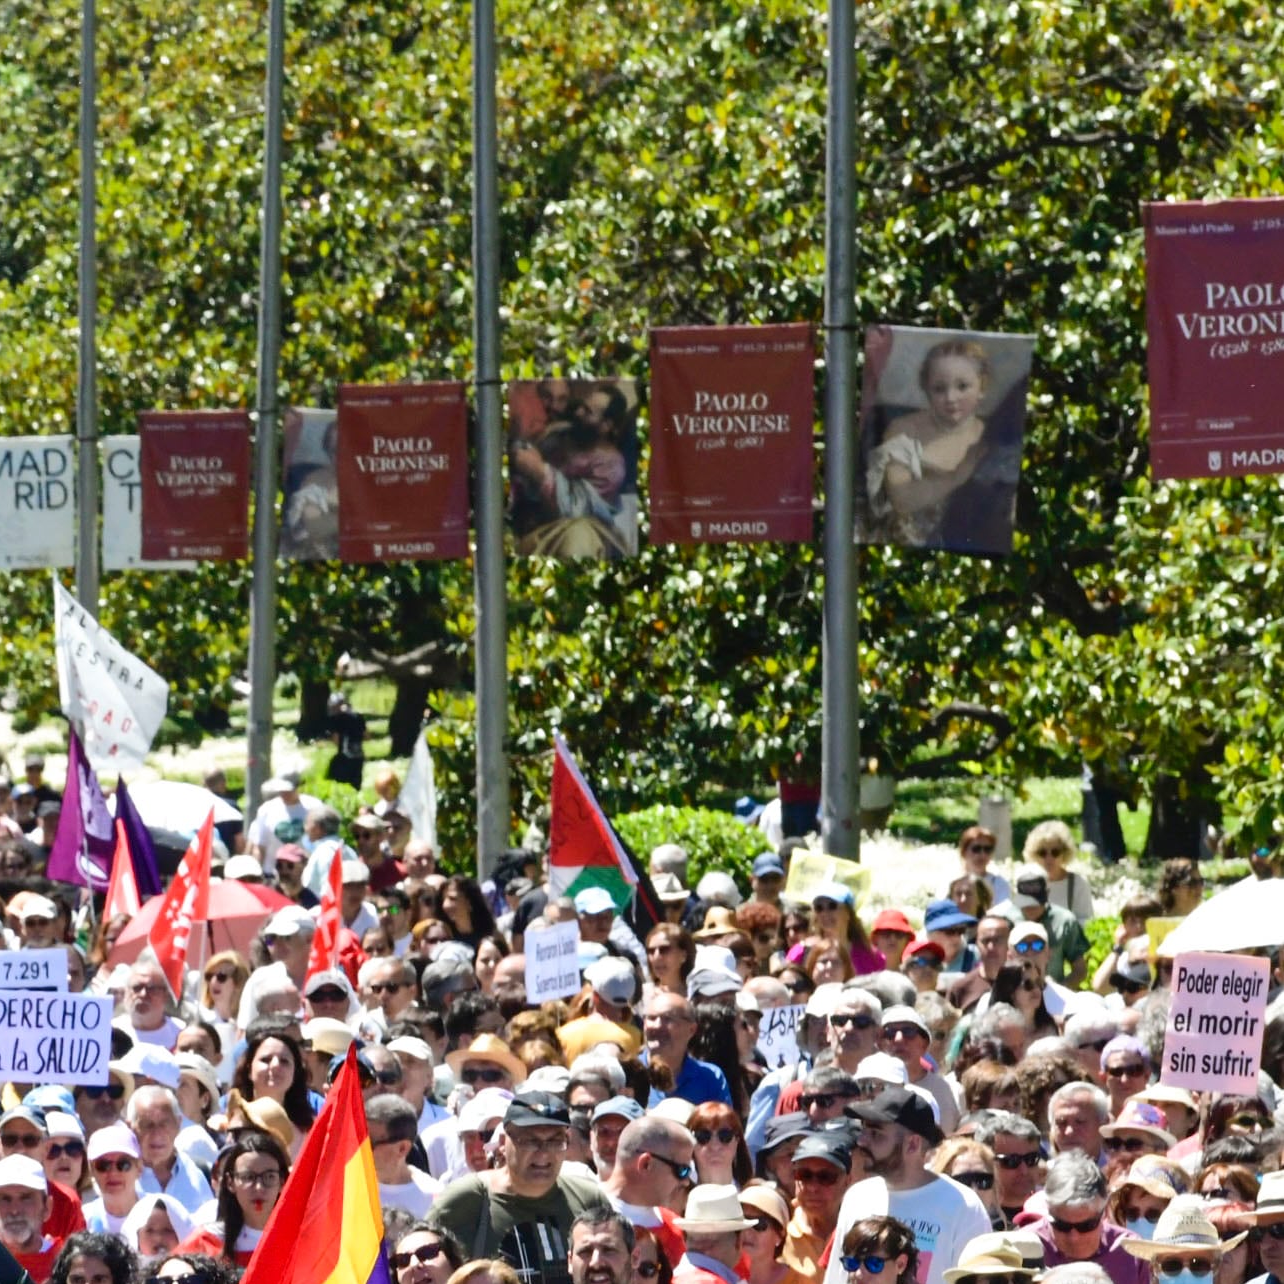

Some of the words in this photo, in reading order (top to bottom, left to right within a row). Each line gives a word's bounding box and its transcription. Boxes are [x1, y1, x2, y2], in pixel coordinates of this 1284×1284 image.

[1206, 223, 1234, 233] Prado
[695, 391, 767, 412] PAOLO
[672, 413, 790, 435] VERONESE
[373, 435, 432, 454] PAOLO
[170, 456, 222, 471] PAOLO
[355, 454, 449, 472] VERONESE
[155, 472, 237, 487] VERONESE
[15, 480, 69, 511] RID
[709, 521, 768, 536] MADRID
[388, 541, 434, 554] MADRID
[2, 960, 52, 980] 7.291
[1177, 966, 1217, 994] Poder
[1221, 968, 1265, 1001] elegir
[1173, 1009, 1193, 1034] el
[1198, 1013, 1259, 1037] morir
[9, 1035, 31, 1072] la
[34, 1036, 101, 1076] SALUD.
[1169, 1050, 1195, 1074] sin
[1200, 1050, 1255, 1078] sufrir.
